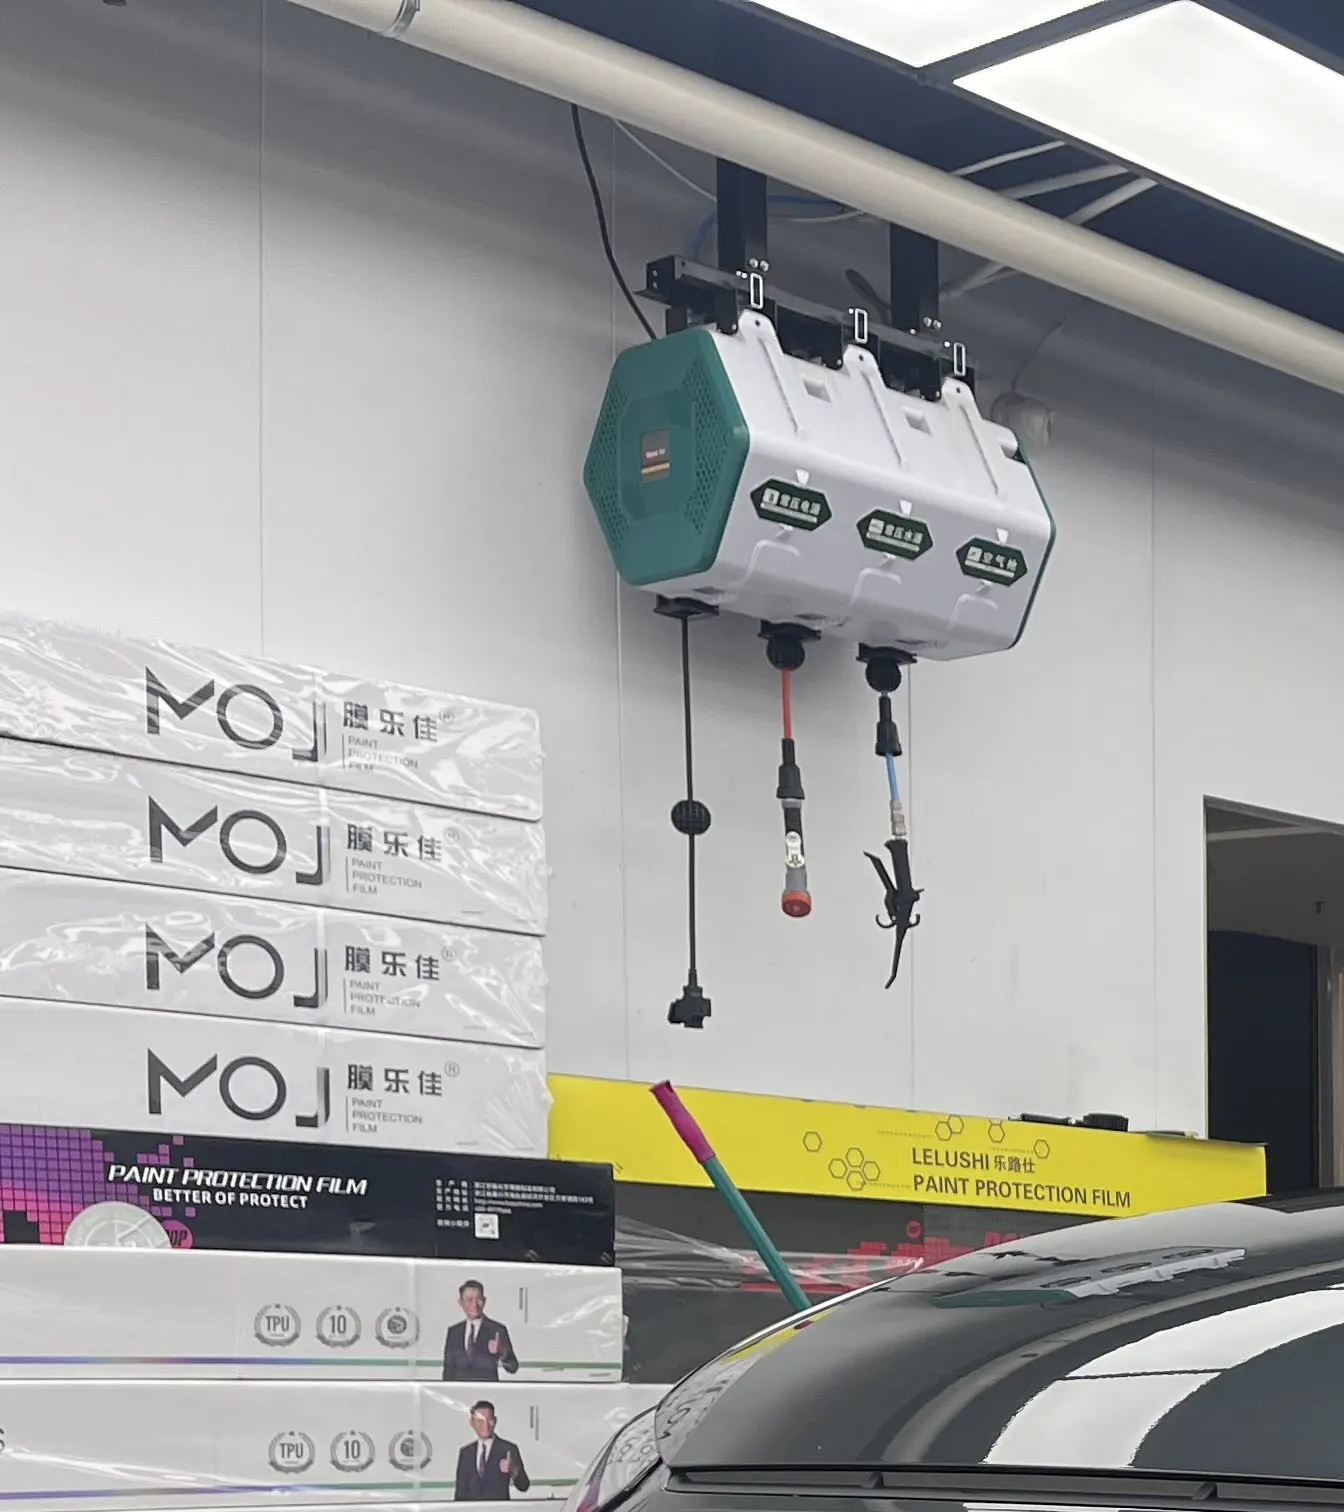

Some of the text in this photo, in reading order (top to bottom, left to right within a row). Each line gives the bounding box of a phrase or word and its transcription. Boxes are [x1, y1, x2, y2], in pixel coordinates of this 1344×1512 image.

[145, 665, 327, 762] MOJ
[349, 735, 379, 749] PAINT
[348, 749, 419, 769] PROTECTION
[148, 795, 331, 885] MOJ
[351, 858, 382, 870] PAINT
[351, 870, 423, 889] PROTECTION
[351, 884, 378, 895] FILM
[145, 922, 328, 1009] MOJ
[350, 979, 380, 992] PAINT
[349, 1004, 376, 1016] FILM
[147, 1048, 331, 1128] MOJ
[351, 1098, 382, 1110] PAINT
[351, 1111, 423, 1125] PROTECTION
[351, 1123, 378, 1133] FILM
[912, 1147, 989, 1171] LELUSHI
[108, 1165, 368, 1196] PAINT PROTECTION FILM
[153, 1188, 308, 1209] BETTER OF PROTECT
[913, 1175, 1131, 1209] PAINT PROTECTION FILM
[265, 1315, 290, 1332] TPU
[329, 1315, 346, 1334] 10
[280, 1442, 304, 1459] TPU
[344, 1439, 361, 1459] 10
